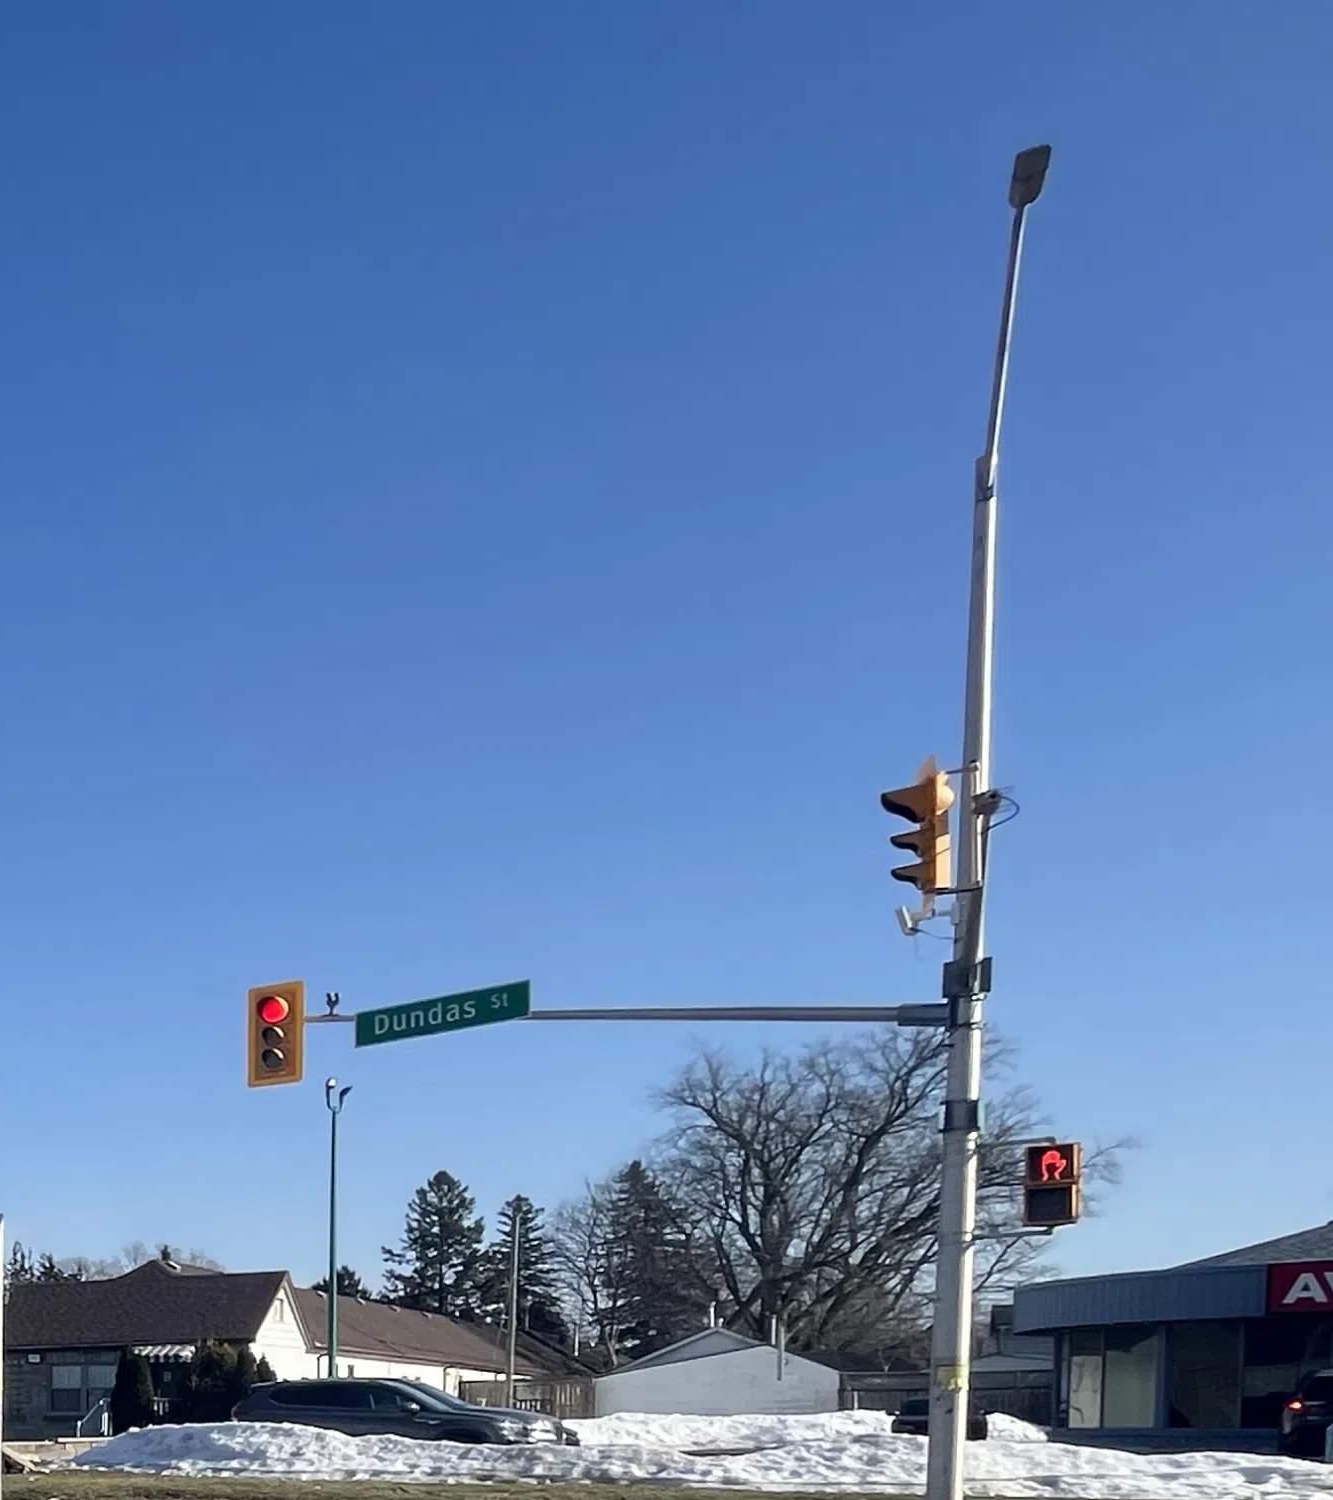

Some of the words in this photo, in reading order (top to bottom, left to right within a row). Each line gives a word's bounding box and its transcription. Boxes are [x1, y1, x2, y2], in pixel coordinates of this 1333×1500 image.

[374, 1000, 476, 1035] Dundas
[490, 992, 509, 1009] St
[1281, 1271, 1333, 1304] A
